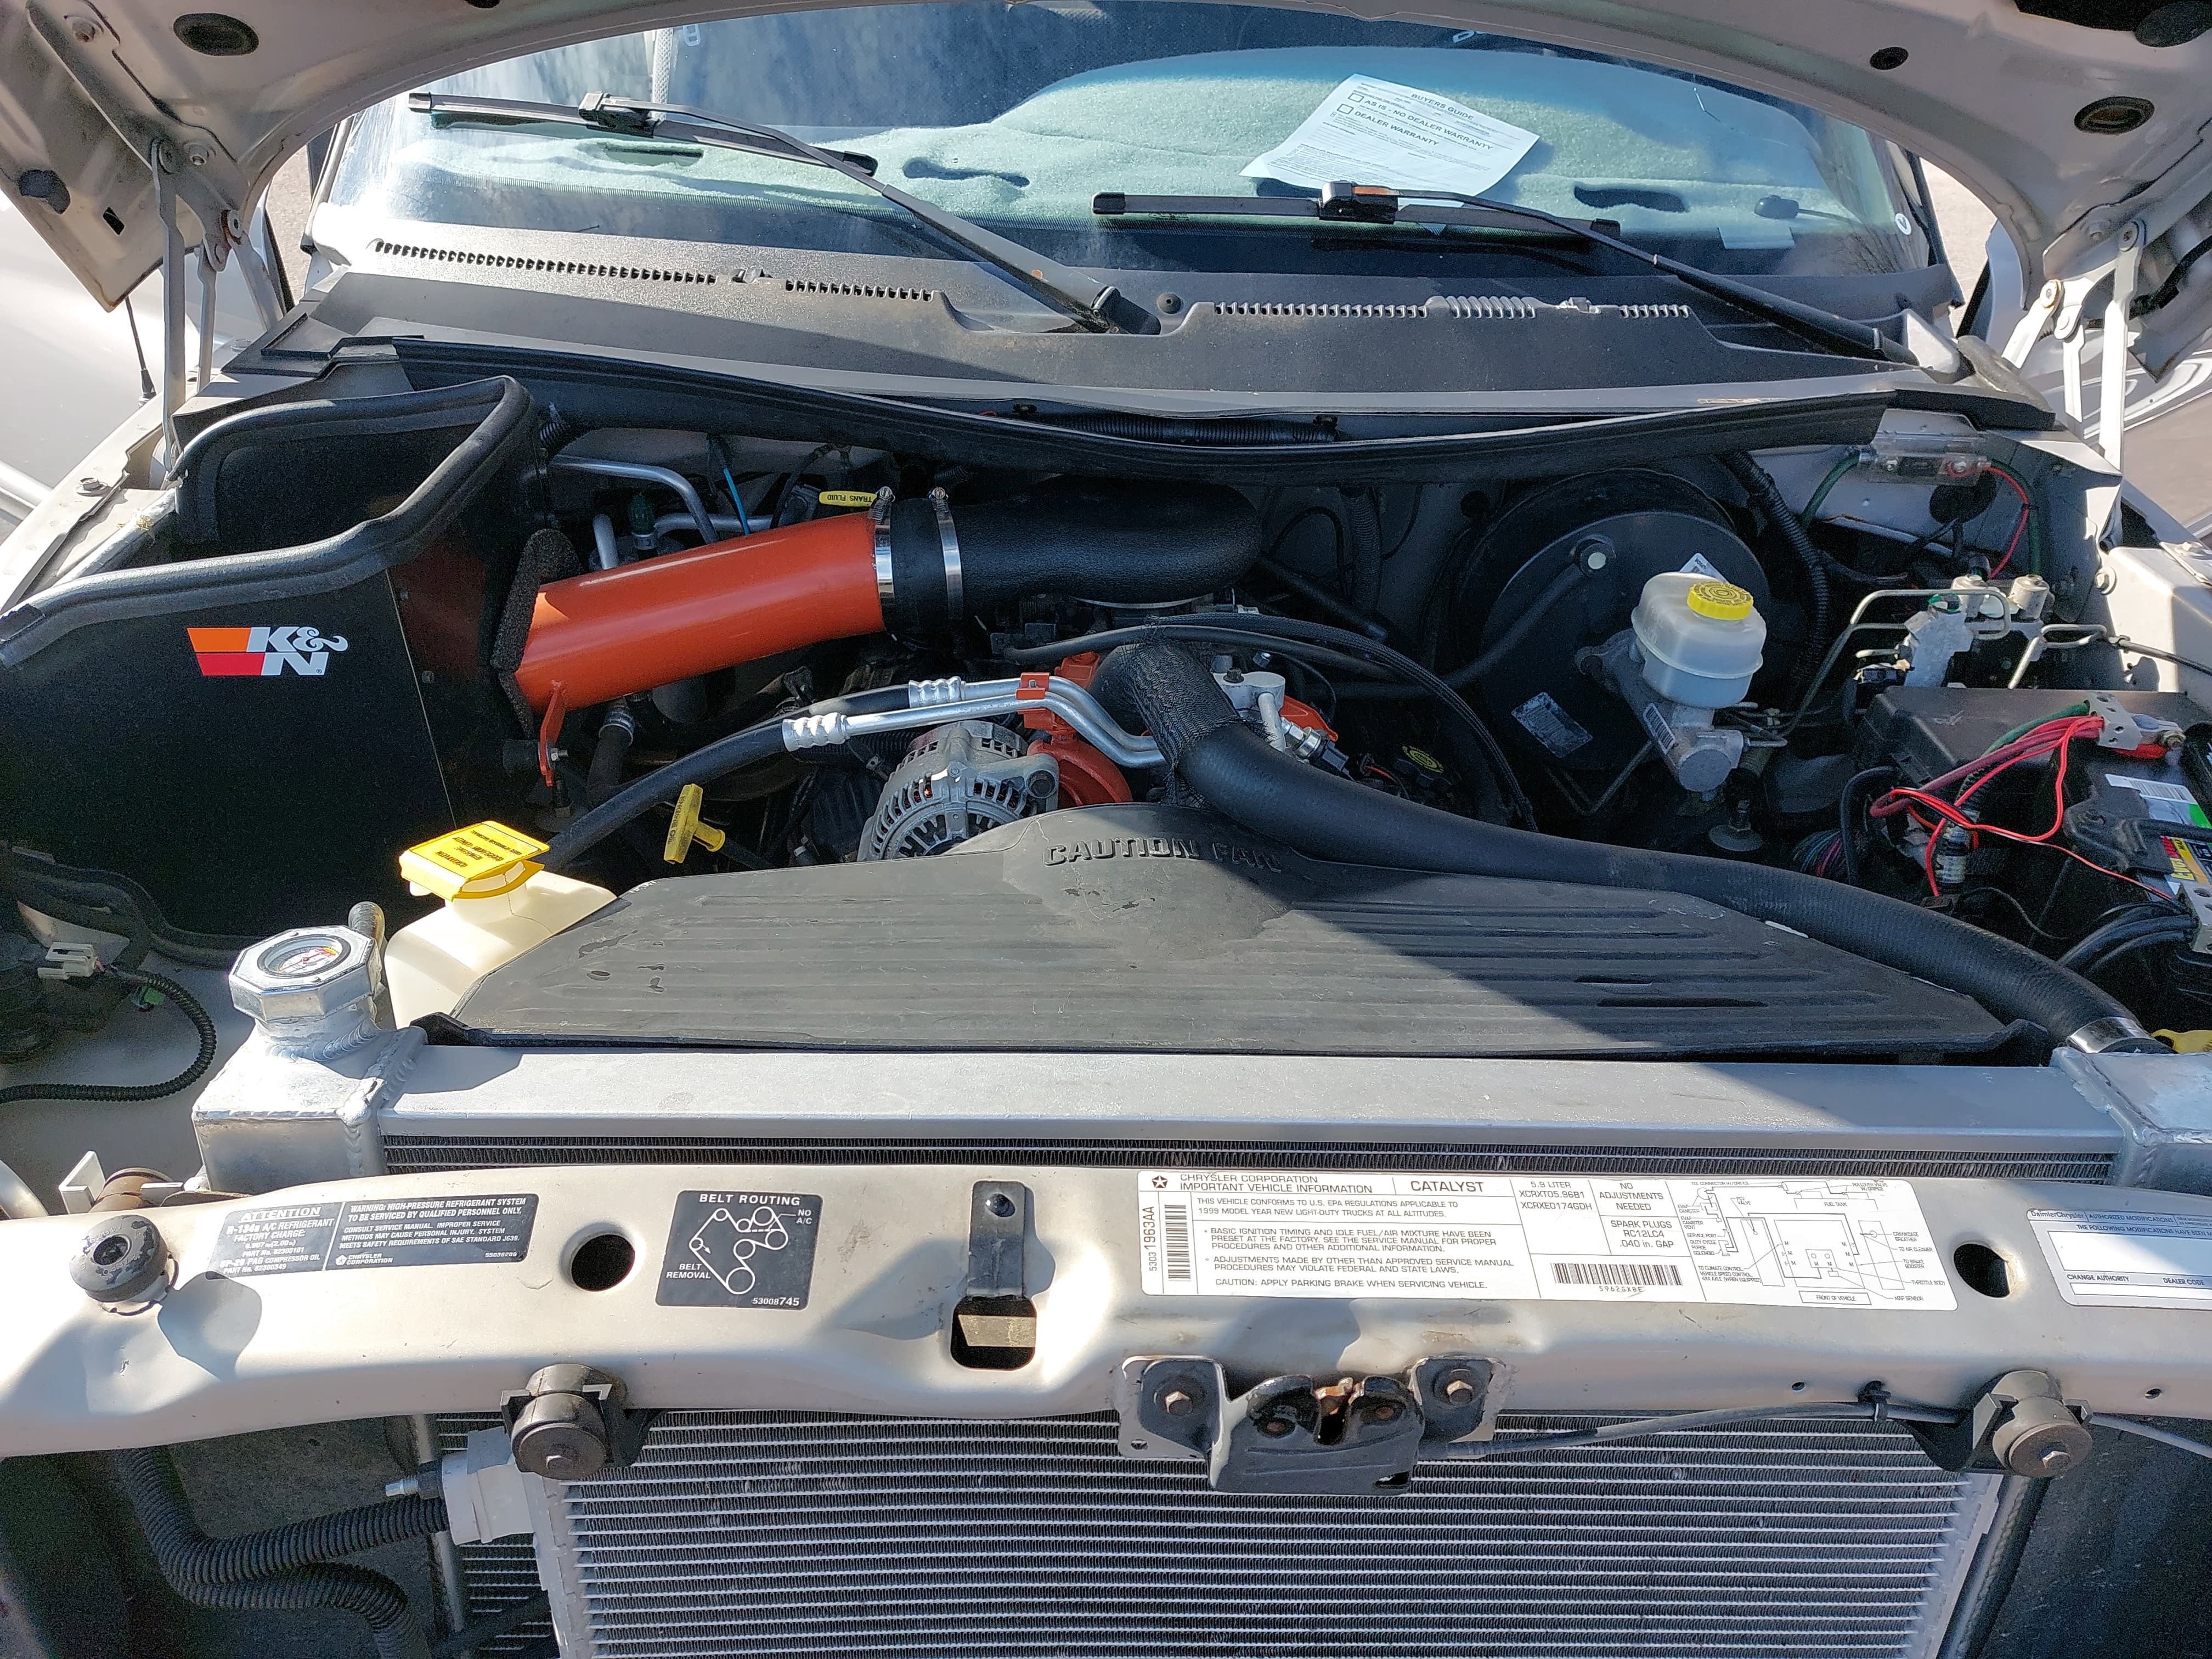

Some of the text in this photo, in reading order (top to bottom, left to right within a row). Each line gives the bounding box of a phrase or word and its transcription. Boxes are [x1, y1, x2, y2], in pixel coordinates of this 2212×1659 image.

[1411, 94, 1475, 121] BUYERS GUIDE
[1354, 111, 1440, 146] DEALER WARRANTY
[1407, 115, 1443, 131] DEALER
[1442, 126, 1493, 151] WARRANTY
[246, 627, 348, 675] K&N
[668, 795, 686, 845] ENGINE OIL
[1043, 837, 1282, 873] CAUTION FAN
[1180, 1182, 1372, 1193] IMPORTANT VEHICLE INFORMATION
[1410, 1181, 1483, 1192] CATALYST
[699, 1194, 800, 1205] BELT ROUTING
[1600, 1192, 1664, 1200] ADJUSTMENTS
[351, 1204, 387, 1212] WARNING:
[387, 1201, 444, 1211] HIGH-PRESSURE
[445, 1199, 496, 1207] REFRIGERANT
[240, 1207, 321, 1221] ATTENTION
[348, 1214, 358, 1222] TO
[359, 1213, 370, 1221] BE
[370, 1212, 406, 1220] SERVICED
[419, 1210, 456, 1218] QUALIFIED
[2031, 1210, 2084, 1220] DaimlerChrysler
[2126, 1215, 2174, 1223] MODIFICATIONS
[261, 1222, 277, 1232] A/C
[278, 1218, 335, 1231] REFRIGERANT
[2128, 1226, 2174, 1234] MODIFICATIONS
[233, 1233, 270, 1242] FACTORY
[1142, 1206, 1157, 1272] 5303 1963AA
[1623, 1229, 1664, 1238] RC12LC4
[1655, 1240, 1674, 1248] GAP
[751, 1297, 800, 1306] 53008745
